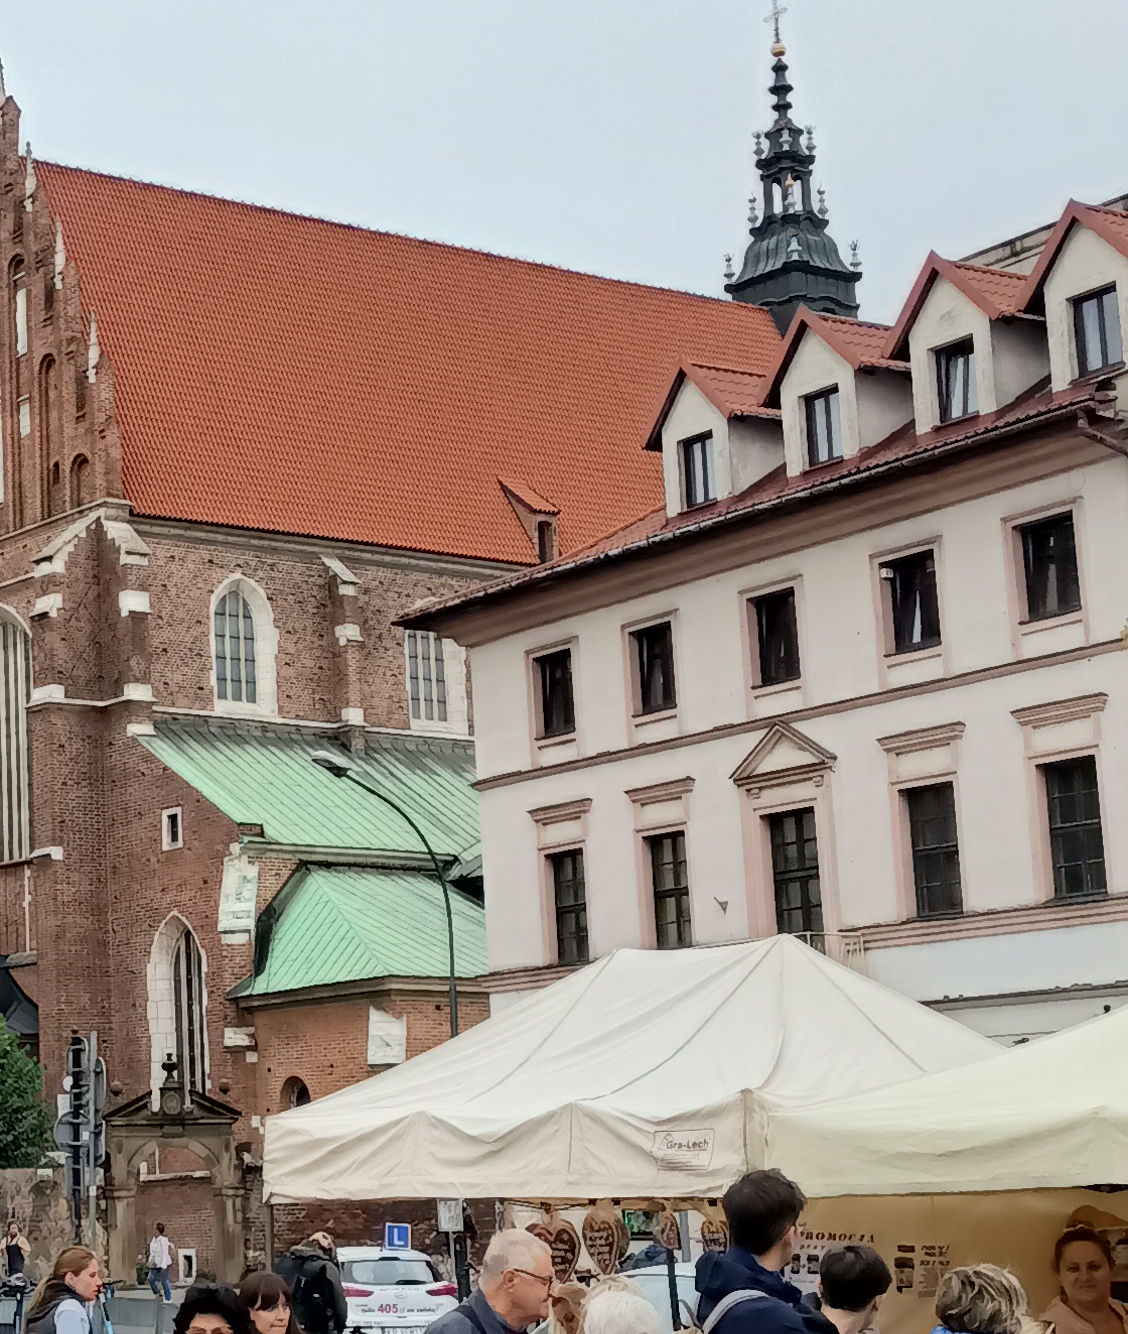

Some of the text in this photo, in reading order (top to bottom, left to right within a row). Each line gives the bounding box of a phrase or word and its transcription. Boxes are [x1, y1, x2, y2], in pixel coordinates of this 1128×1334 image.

[666, 1138, 709, 1149] Gra-Lech
[393, 1227, 405, 1245] L
[377, 1303, 399, 1314] 405
